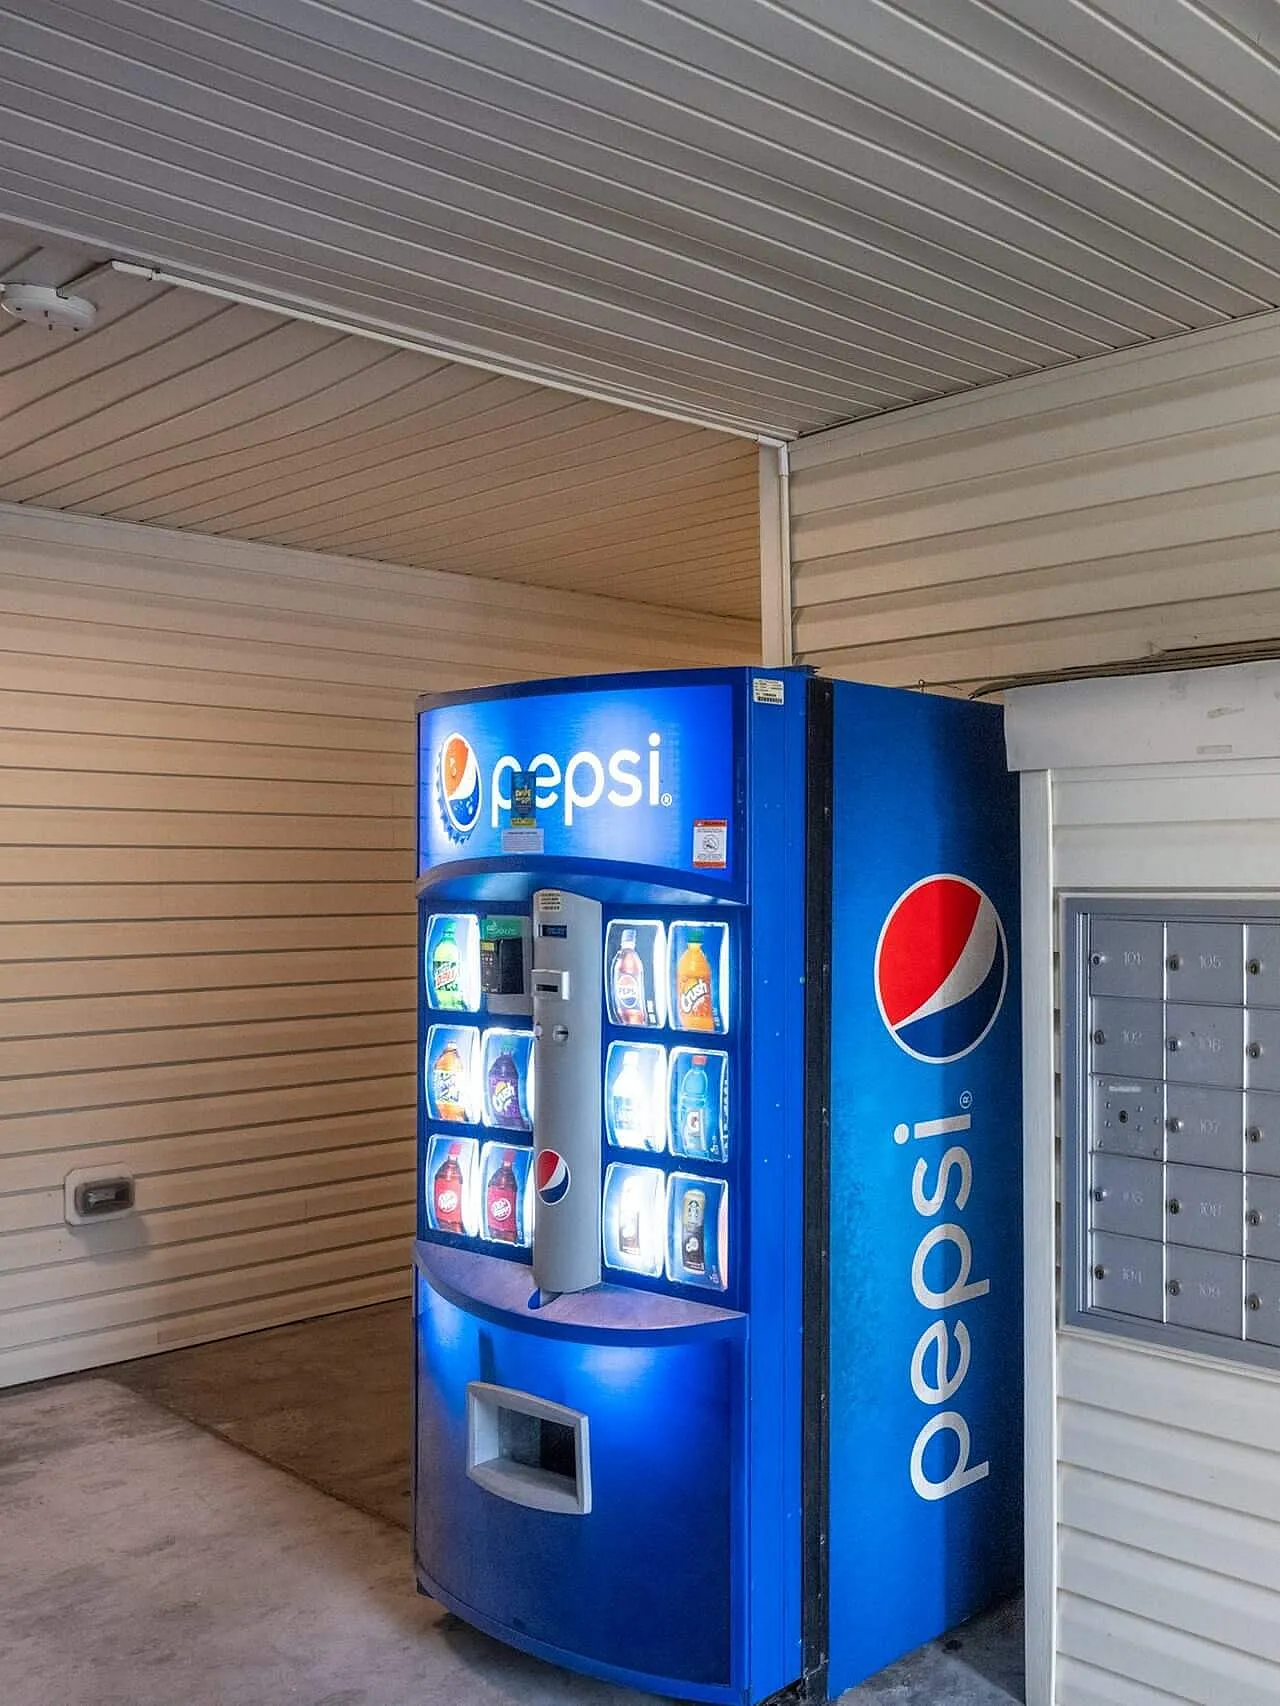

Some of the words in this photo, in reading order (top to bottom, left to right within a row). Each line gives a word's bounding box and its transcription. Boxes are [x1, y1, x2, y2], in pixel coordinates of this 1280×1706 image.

[491, 732, 661, 828] pepsi
[681, 979, 708, 1013] Crush
[893, 1112, 991, 1501] pepsi
